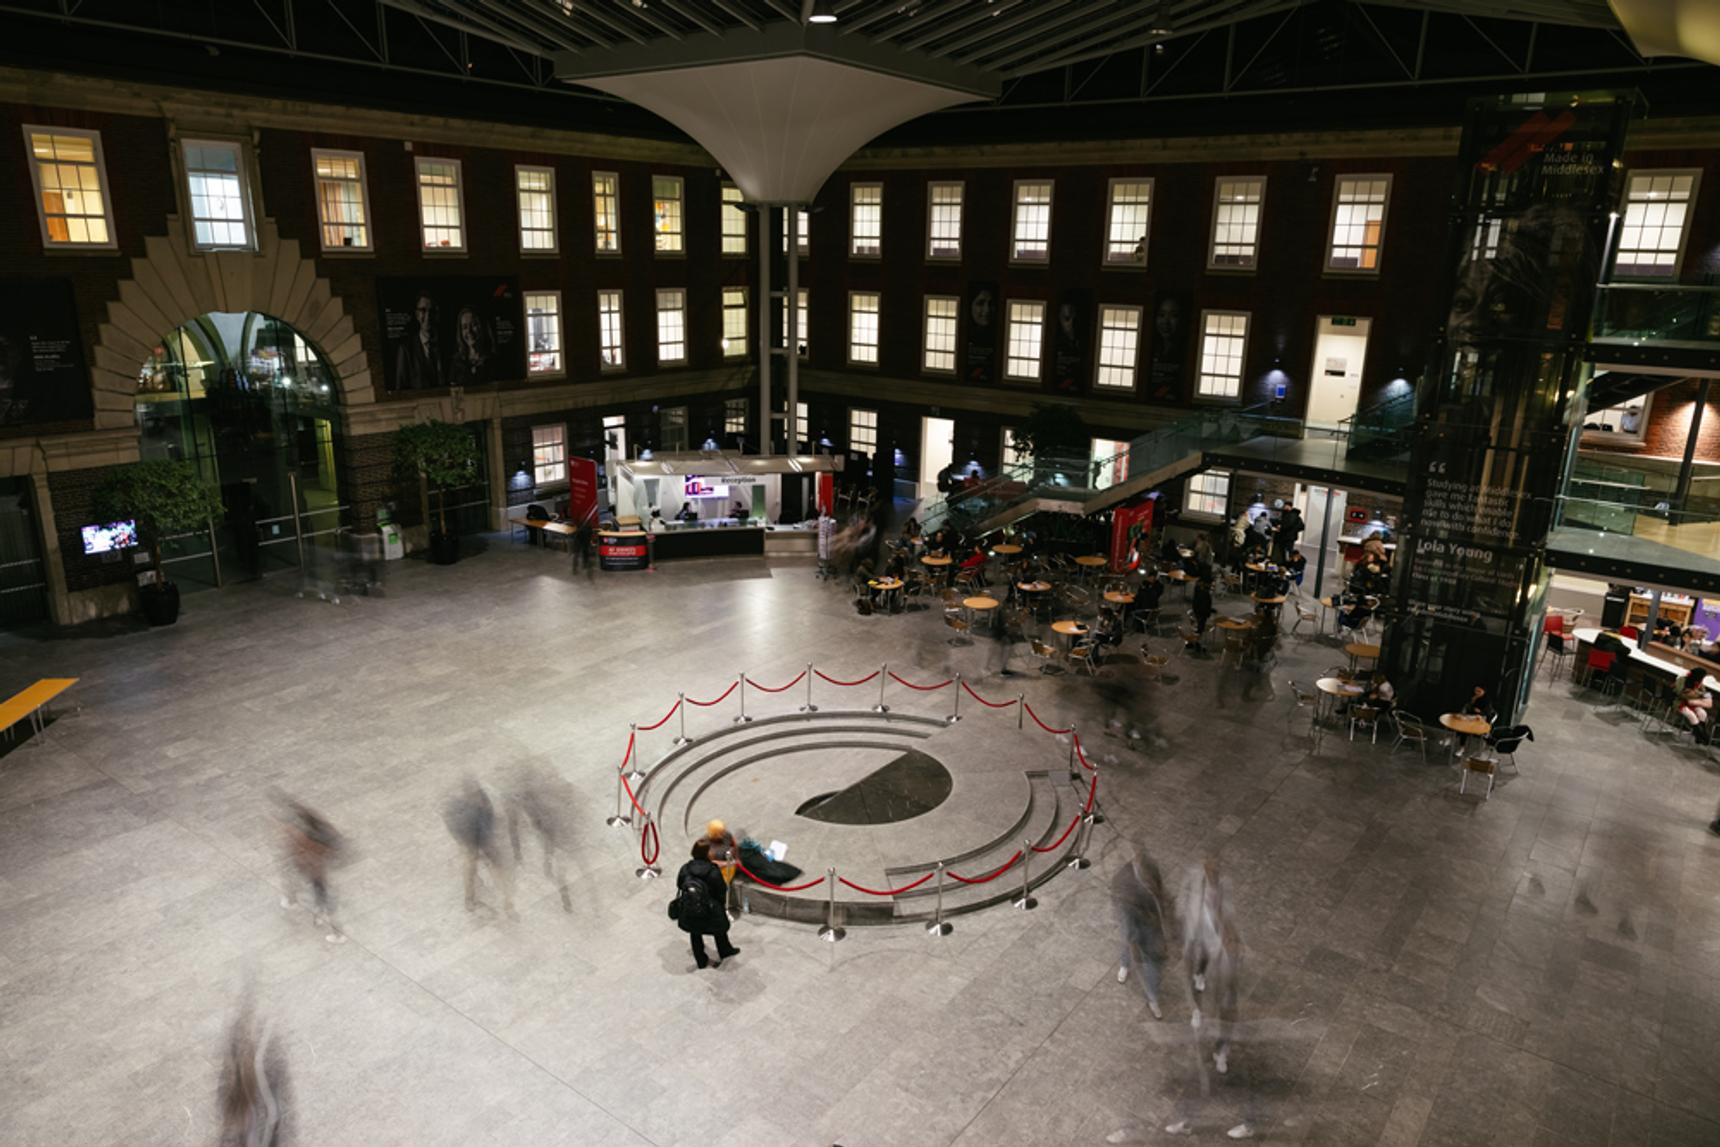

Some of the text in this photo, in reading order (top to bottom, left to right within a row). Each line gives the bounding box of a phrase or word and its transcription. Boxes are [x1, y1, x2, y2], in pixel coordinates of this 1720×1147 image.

[1543, 152, 1594, 163] Made in
[1541, 164, 1604, 175] Middlesex
[721, 477, 756, 485] Reception
[1427, 478, 1467, 492] Studying
[1425, 489, 1448, 499] gave
[1424, 498, 1446, 509] skills
[1440, 510, 1450, 519] to
[1452, 511, 1464, 520] do
[1499, 518, 1512, 528] do
[1417, 538, 1493, 564] Lola Young
